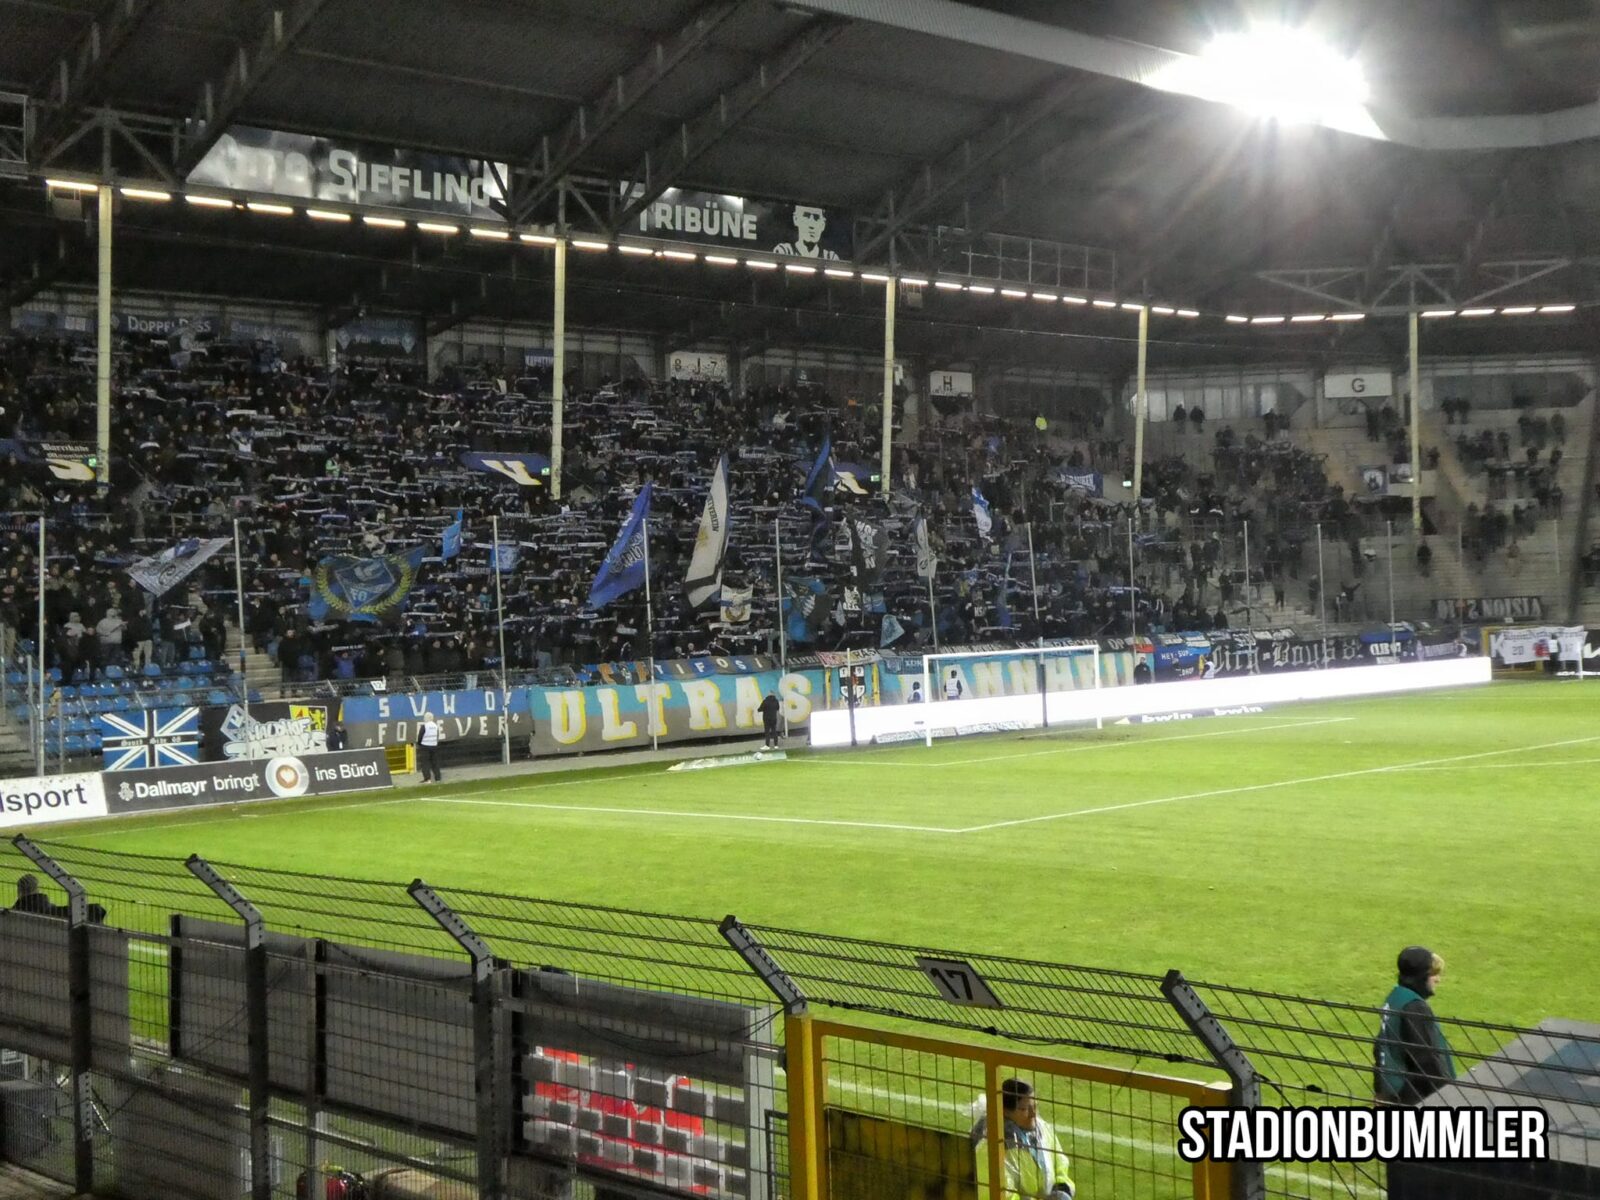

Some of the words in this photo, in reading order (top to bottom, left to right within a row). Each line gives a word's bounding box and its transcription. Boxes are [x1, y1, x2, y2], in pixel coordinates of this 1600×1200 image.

[942, 375, 953, 392] H
[1351, 377, 1366, 393] G
[545, 672, 812, 745] ULTRAS
[135, 778, 207, 799] Dallmayr
[214, 772, 261, 793] bringt
[315, 765, 338, 782] ins
[340, 764, 379, 779] Büro!
[930, 967, 974, 1001] 17
